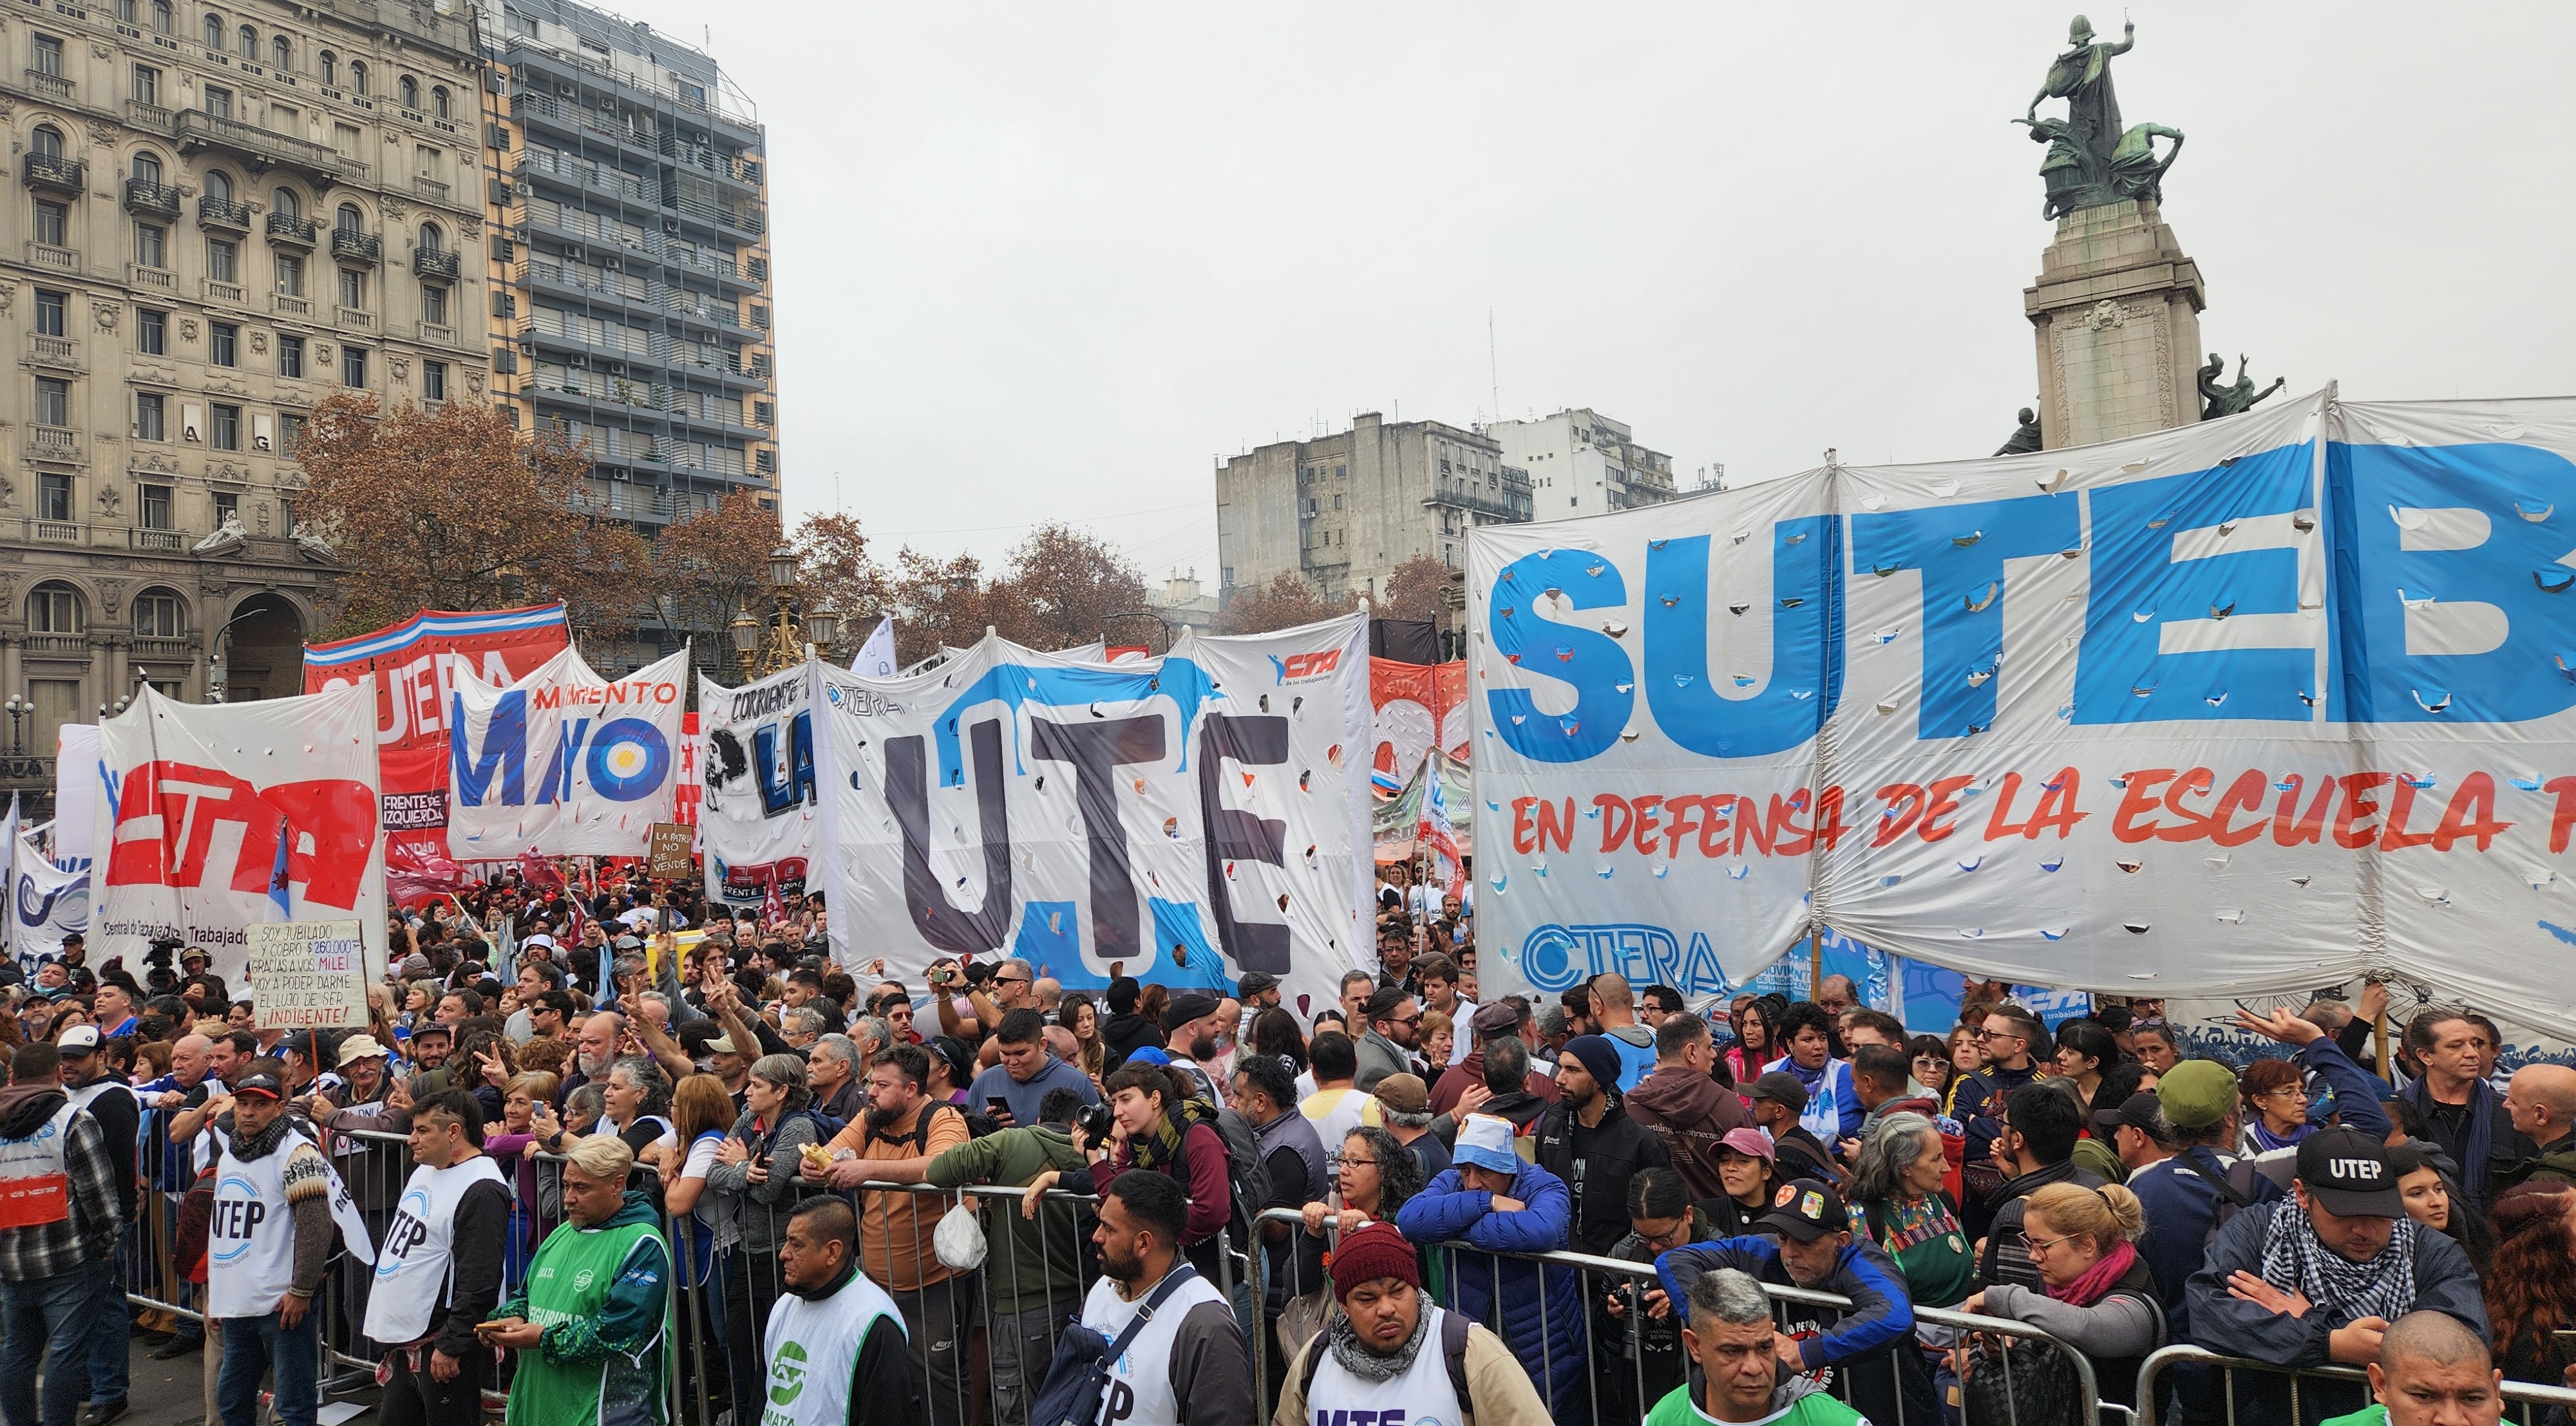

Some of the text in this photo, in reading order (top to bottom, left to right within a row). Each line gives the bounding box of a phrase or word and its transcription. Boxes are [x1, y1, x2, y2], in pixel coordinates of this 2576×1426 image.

[131, 559, 303, 580] INSTITUTO BIOLOGICO
[1284, 648, 1342, 679] CTA
[1300, 675, 1331, 684] trabajadores
[731, 677, 802, 722] CORRIENTE
[383, 794, 442, 810] FRENTE DE
[383, 807, 444, 825] IZQUIERDA
[1512, 796, 1577, 855] EN
[1593, 786, 1855, 858] DEFENSA
[1870, 774, 1976, 849] DE
[1984, 766, 2092, 843] LA
[2112, 766, 2517, 853] ESCUELA
[670, 832, 693, 843] PATRIA
[884, 711, 1291, 975] UTE
[662, 843, 679, 851] NO
[654, 852, 668, 862] SE
[653, 859, 687, 872] VENDE
[723, 885, 757, 897] FRENTE
[104, 921, 129, 936] Central
[261, 924, 332, 941] SOY JUBILADO
[261, 944, 267, 957] Y
[270, 943, 302, 957] COBRO
[252, 958, 287, 973] GRACIAS
[289, 961, 296, 972] A
[298, 959, 315, 972] VOS
[1522, 924, 1736, 997] CTERA
[254, 975, 351, 991] VOY A PODER DARME
[1769, 976, 1794, 984] UNIDAD
[260, 991, 343, 1008] EL LUJO DE SER
[2025, 990, 2087, 1011] CTA
[2329, 1158, 2382, 1179] UTEP
[935, 1340, 953, 1349] NIKE
